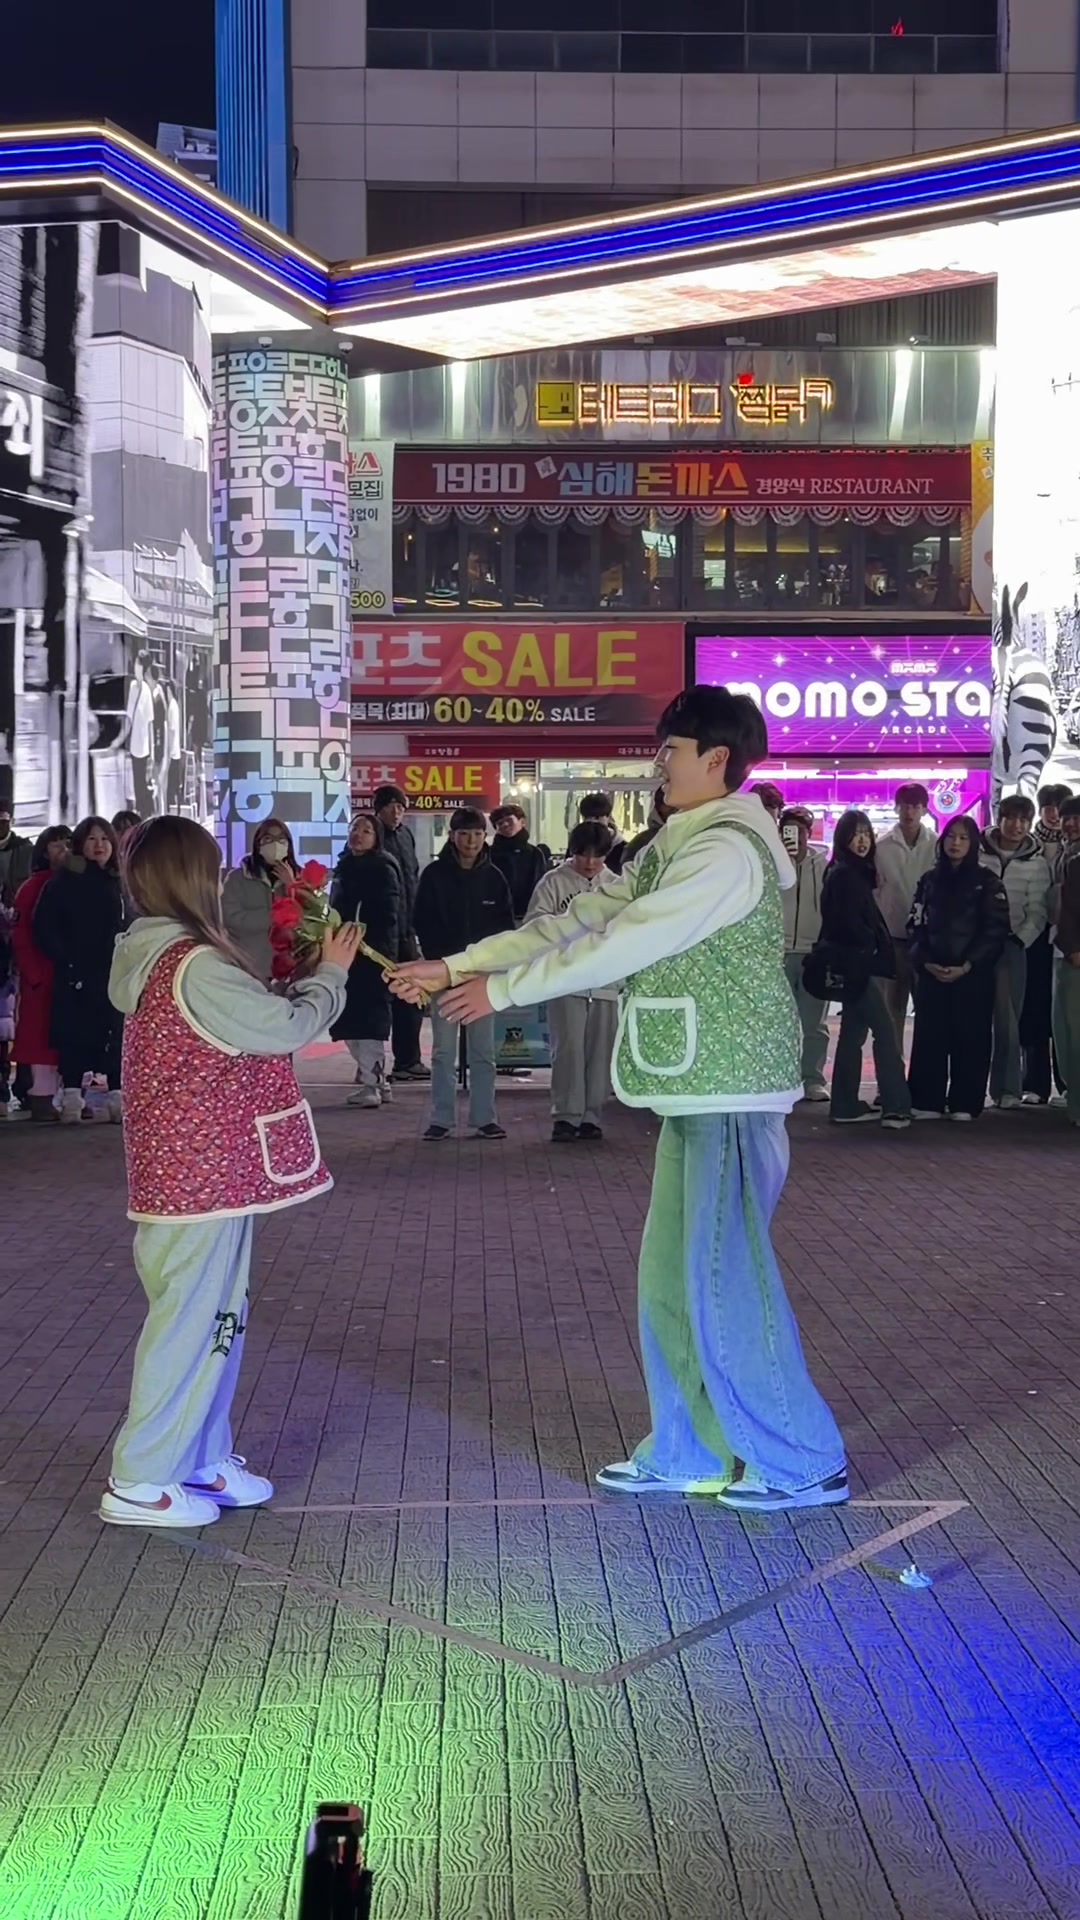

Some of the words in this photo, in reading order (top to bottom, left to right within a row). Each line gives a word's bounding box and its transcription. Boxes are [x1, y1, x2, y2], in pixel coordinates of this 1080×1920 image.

[728, 376, 836, 424] 찜닭
[432, 463, 526, 493] 1980
[557, 462, 749, 496] 심해돈까스
[756, 478, 805, 494] 경양식
[810, 478, 933, 494] RESTAURANT
[461, 630, 637, 687] SALE
[550, 707, 595, 721] SALE
[880, 725, 948, 734] ARCADE
[404, 765, 483, 792] SALE
[444, 800, 464, 808] SALE
